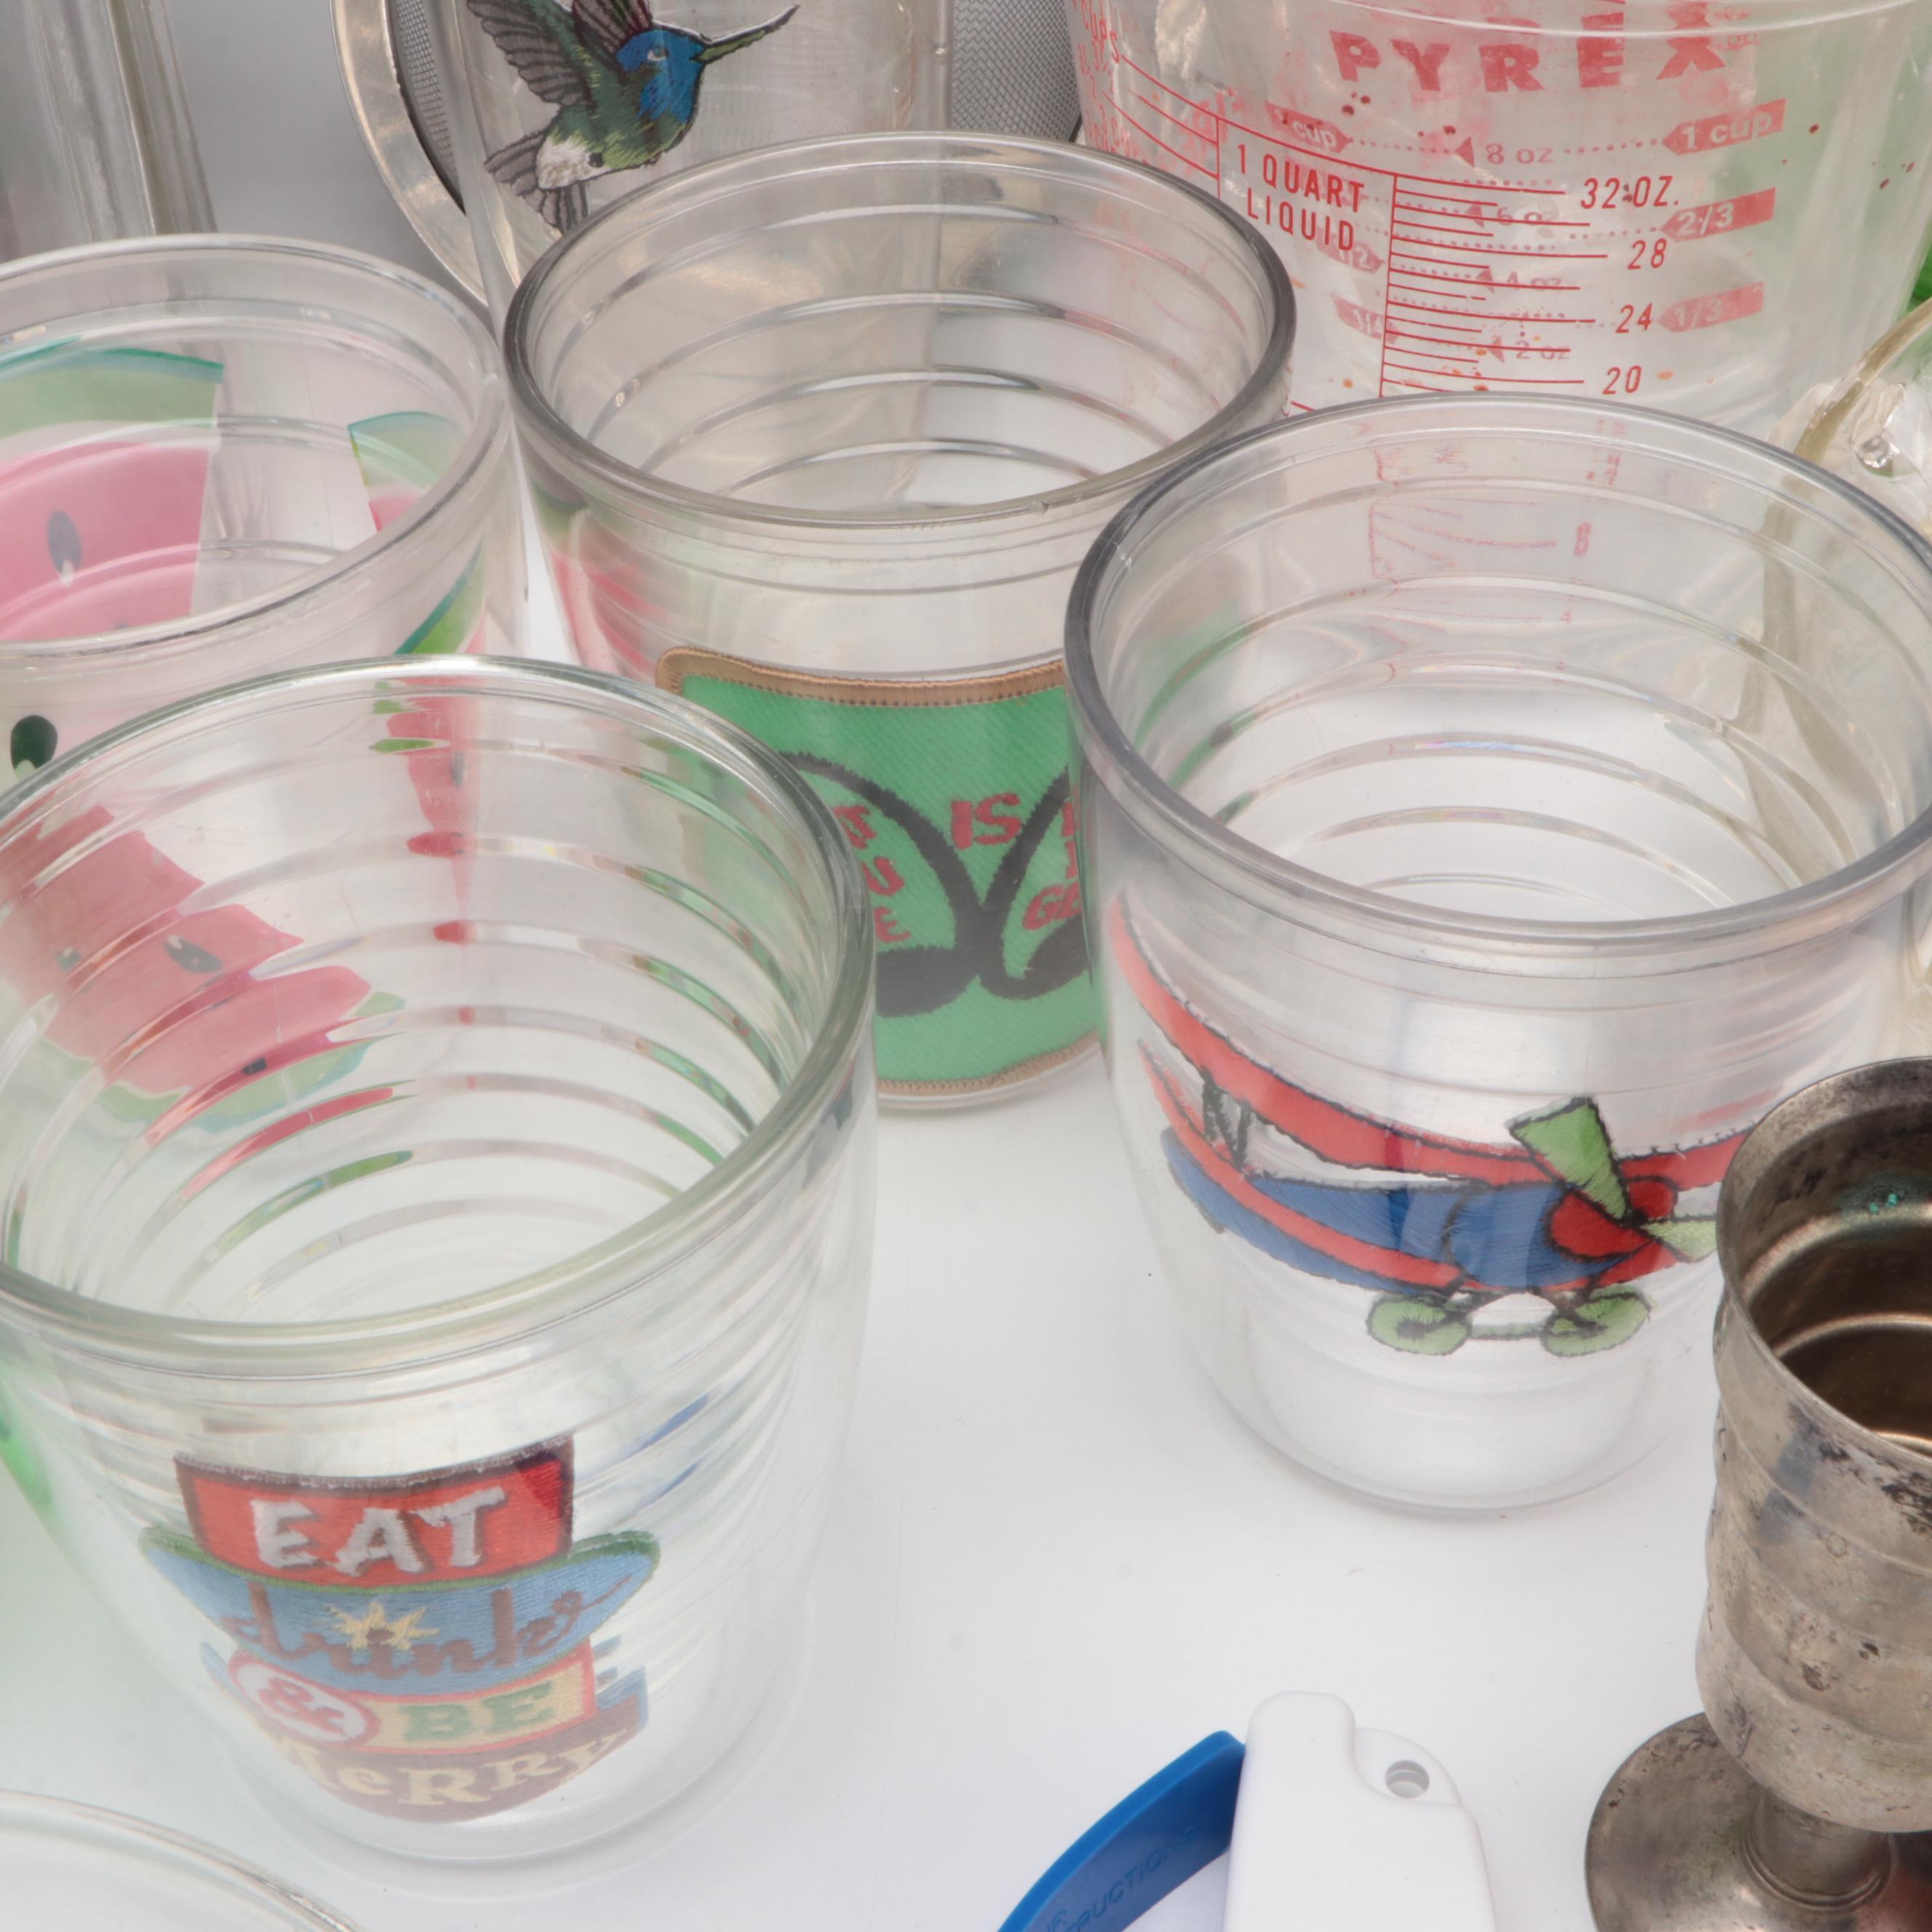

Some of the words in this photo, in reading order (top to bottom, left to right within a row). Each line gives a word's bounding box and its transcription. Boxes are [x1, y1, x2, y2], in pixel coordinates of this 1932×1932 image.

[1328, 29, 1725, 92] PYREX
[1682, 125, 1698, 150] 1
[1710, 113, 1773, 143] cup
[1485, 143, 1505, 164] 8
[1238, 143, 1246, 175] 1
[1262, 153, 1365, 213] QUART
[1580, 177, 1621, 209] 32
[1247, 187, 1355, 252] LIQUID
[1676, 201, 1736, 236] 2/3
[1627, 237, 1668, 271] 28
[1615, 302, 1653, 334] 24
[1674, 298, 1723, 328] 1/3
[1602, 364, 1642, 395] 20
[250, 1485, 507, 1577] EAT
[258, 1676, 346, 1738] &
[396, 1680, 556, 1743] BE
